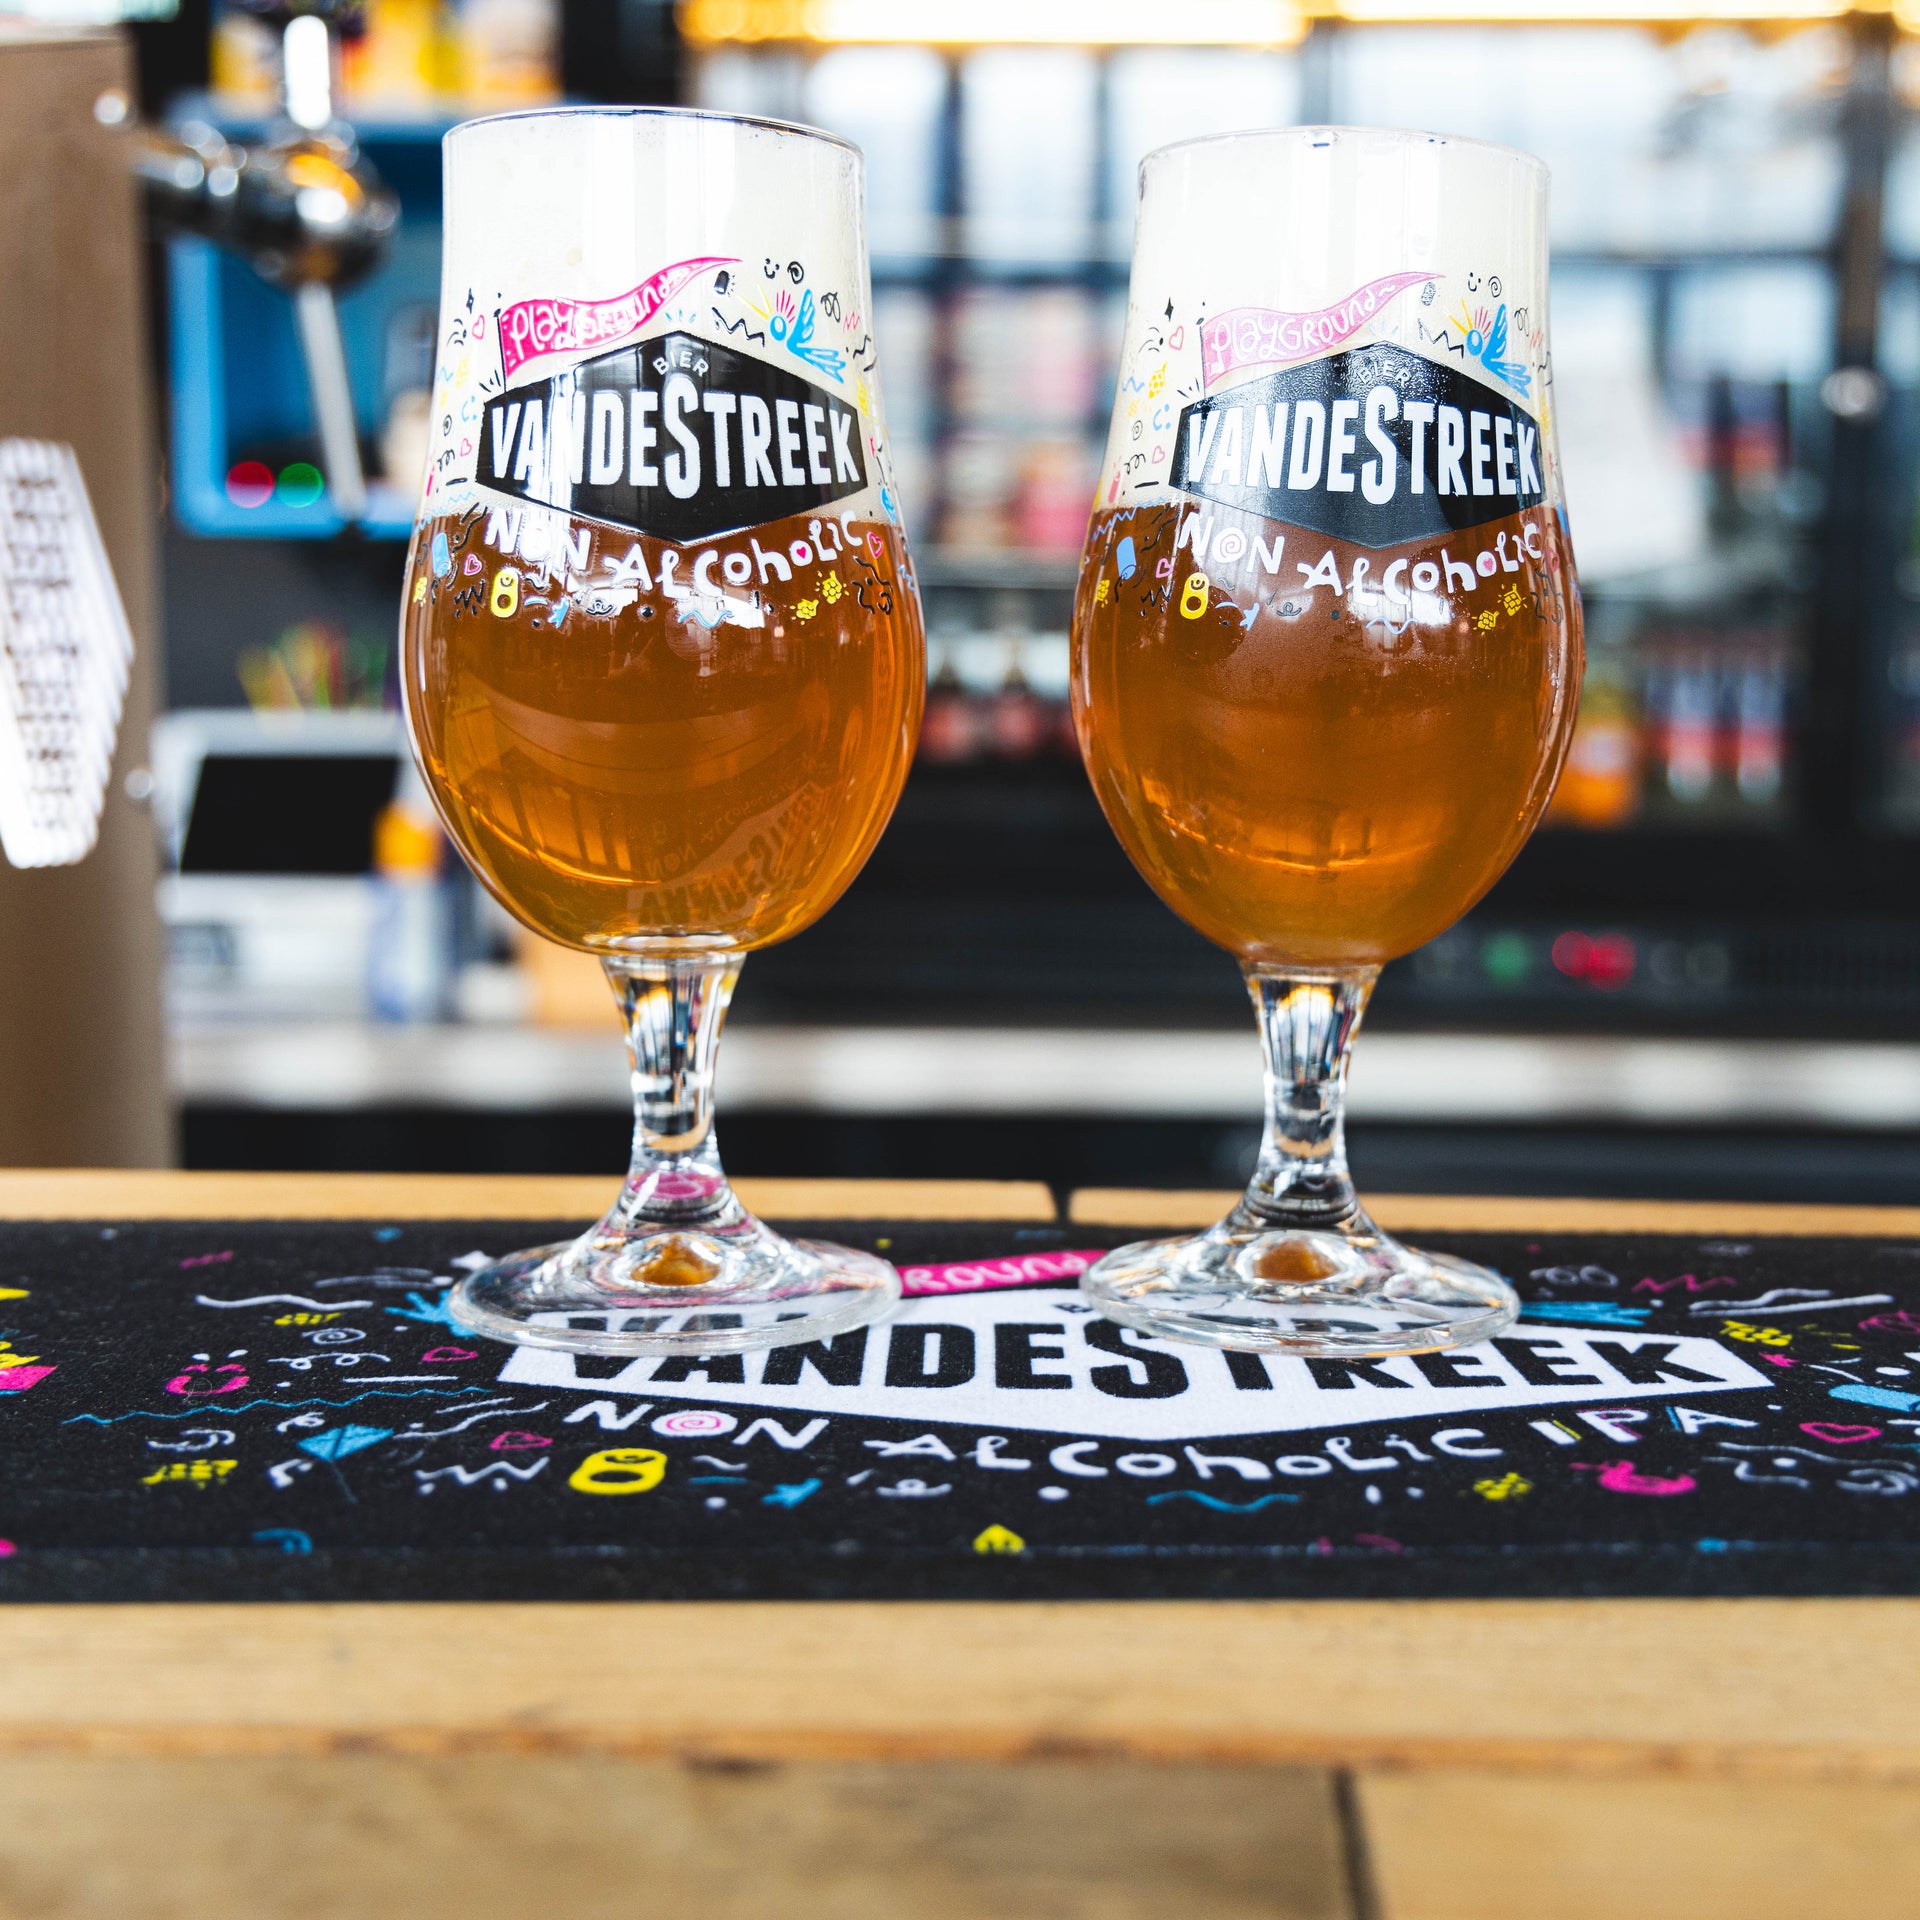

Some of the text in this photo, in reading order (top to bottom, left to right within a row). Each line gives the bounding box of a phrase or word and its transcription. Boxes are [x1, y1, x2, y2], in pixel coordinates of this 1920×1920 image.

[652, 350, 710, 377] BIER
[1357, 360, 1411, 387] BIER
[490, 375, 861, 499] VANDESTREEK
[1188, 386, 1542, 505] VANDESTREEK
[484, 508, 592, 571] NON
[1177, 511, 1286, 574] NON
[562, 1400, 830, 1449] NON
[1528, 1405, 1761, 1446] IPA
